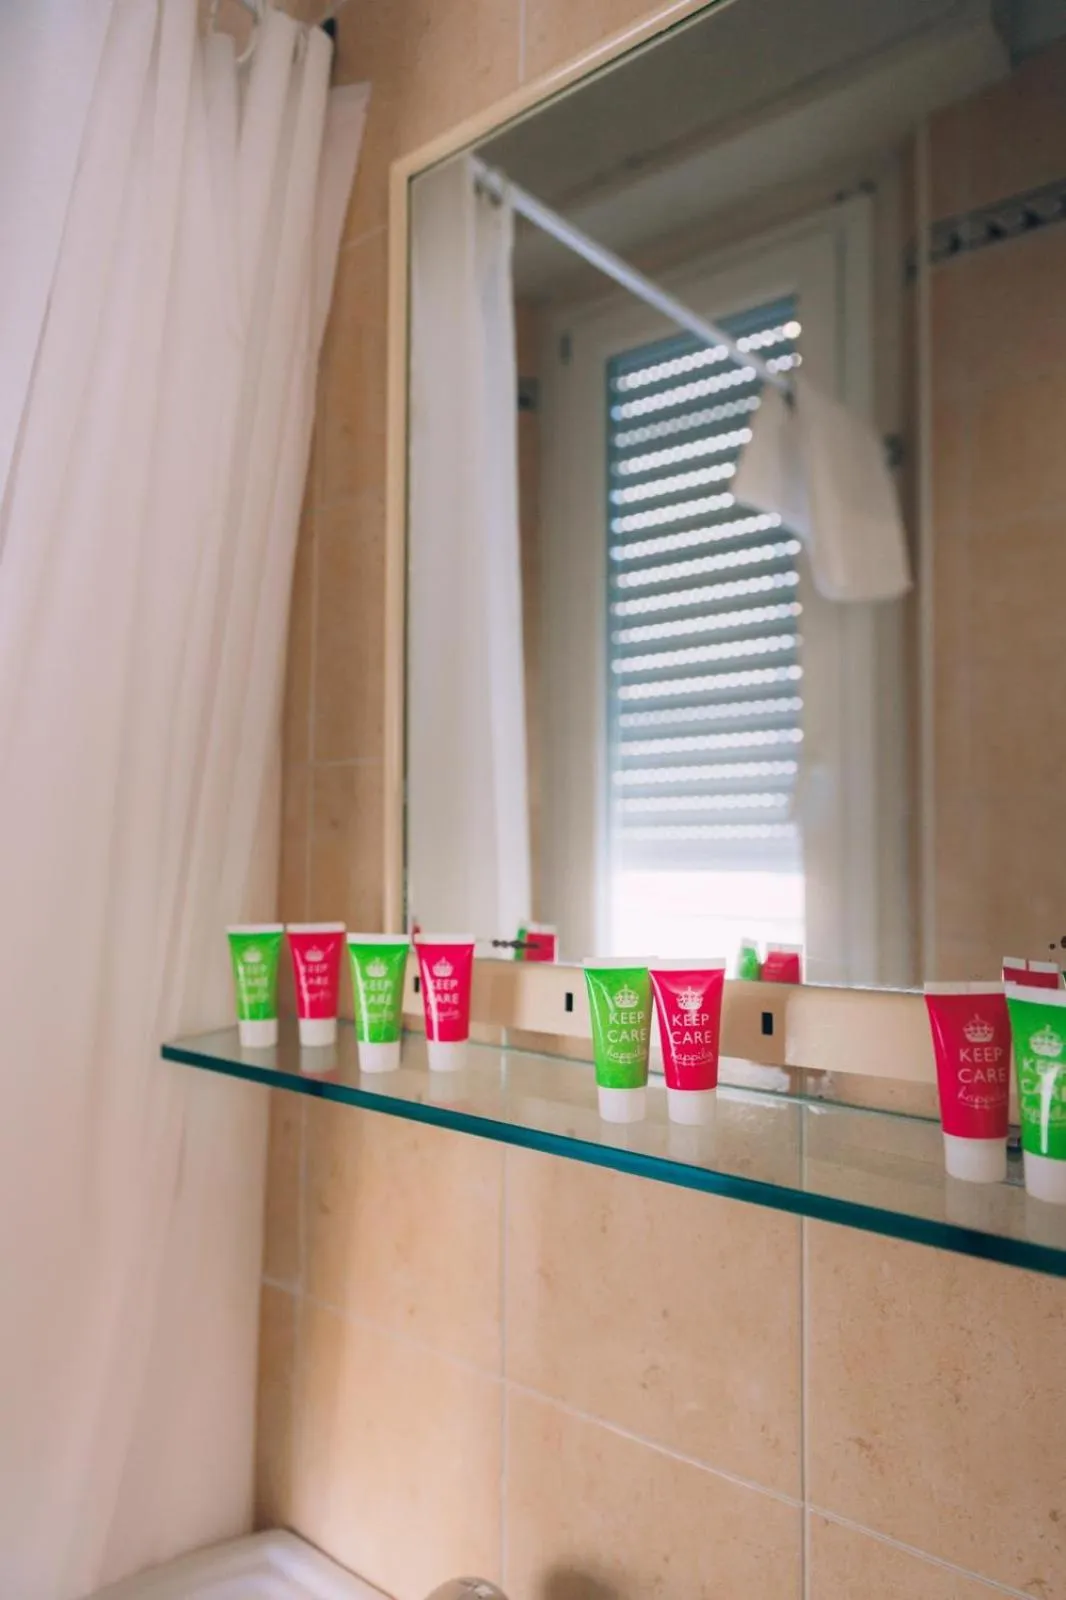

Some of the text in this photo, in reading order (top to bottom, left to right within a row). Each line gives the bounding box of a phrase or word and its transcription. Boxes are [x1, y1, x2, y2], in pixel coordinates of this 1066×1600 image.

[609, 1012, 644, 1024] KEEP
[672, 1013, 710, 1026] KEEP
[607, 1029, 647, 1042] CARE
[671, 1031, 712, 1044] CARE
[959, 1047, 1003, 1062] KEEP
[957, 1068, 1006, 1083] CARE
